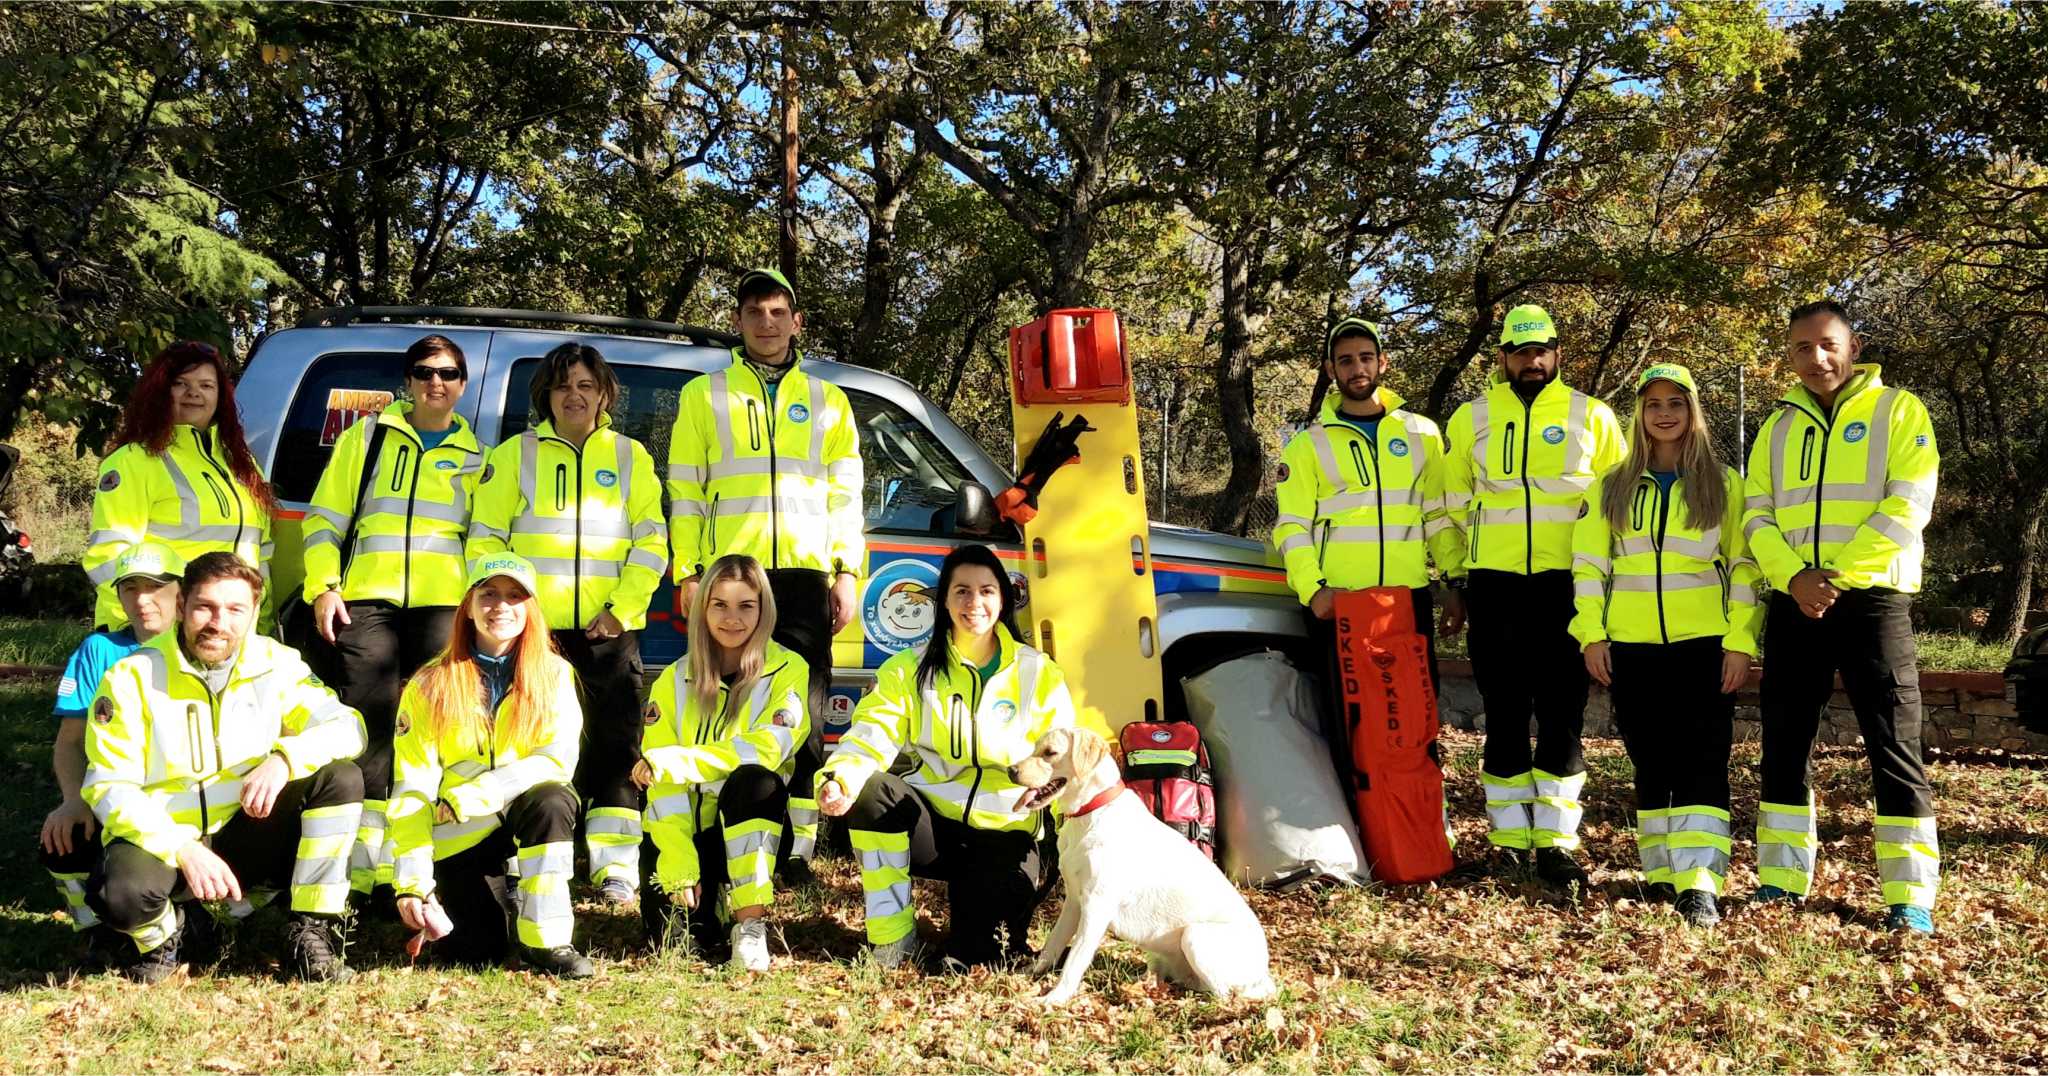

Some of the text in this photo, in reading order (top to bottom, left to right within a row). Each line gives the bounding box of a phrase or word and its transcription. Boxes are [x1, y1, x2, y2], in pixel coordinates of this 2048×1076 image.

[1512, 321, 1545, 333] RESCUE
[485, 559, 526, 572] RESCUE
[1339, 617, 1359, 695] SKED
[1381, 671, 1400, 731] SKED
